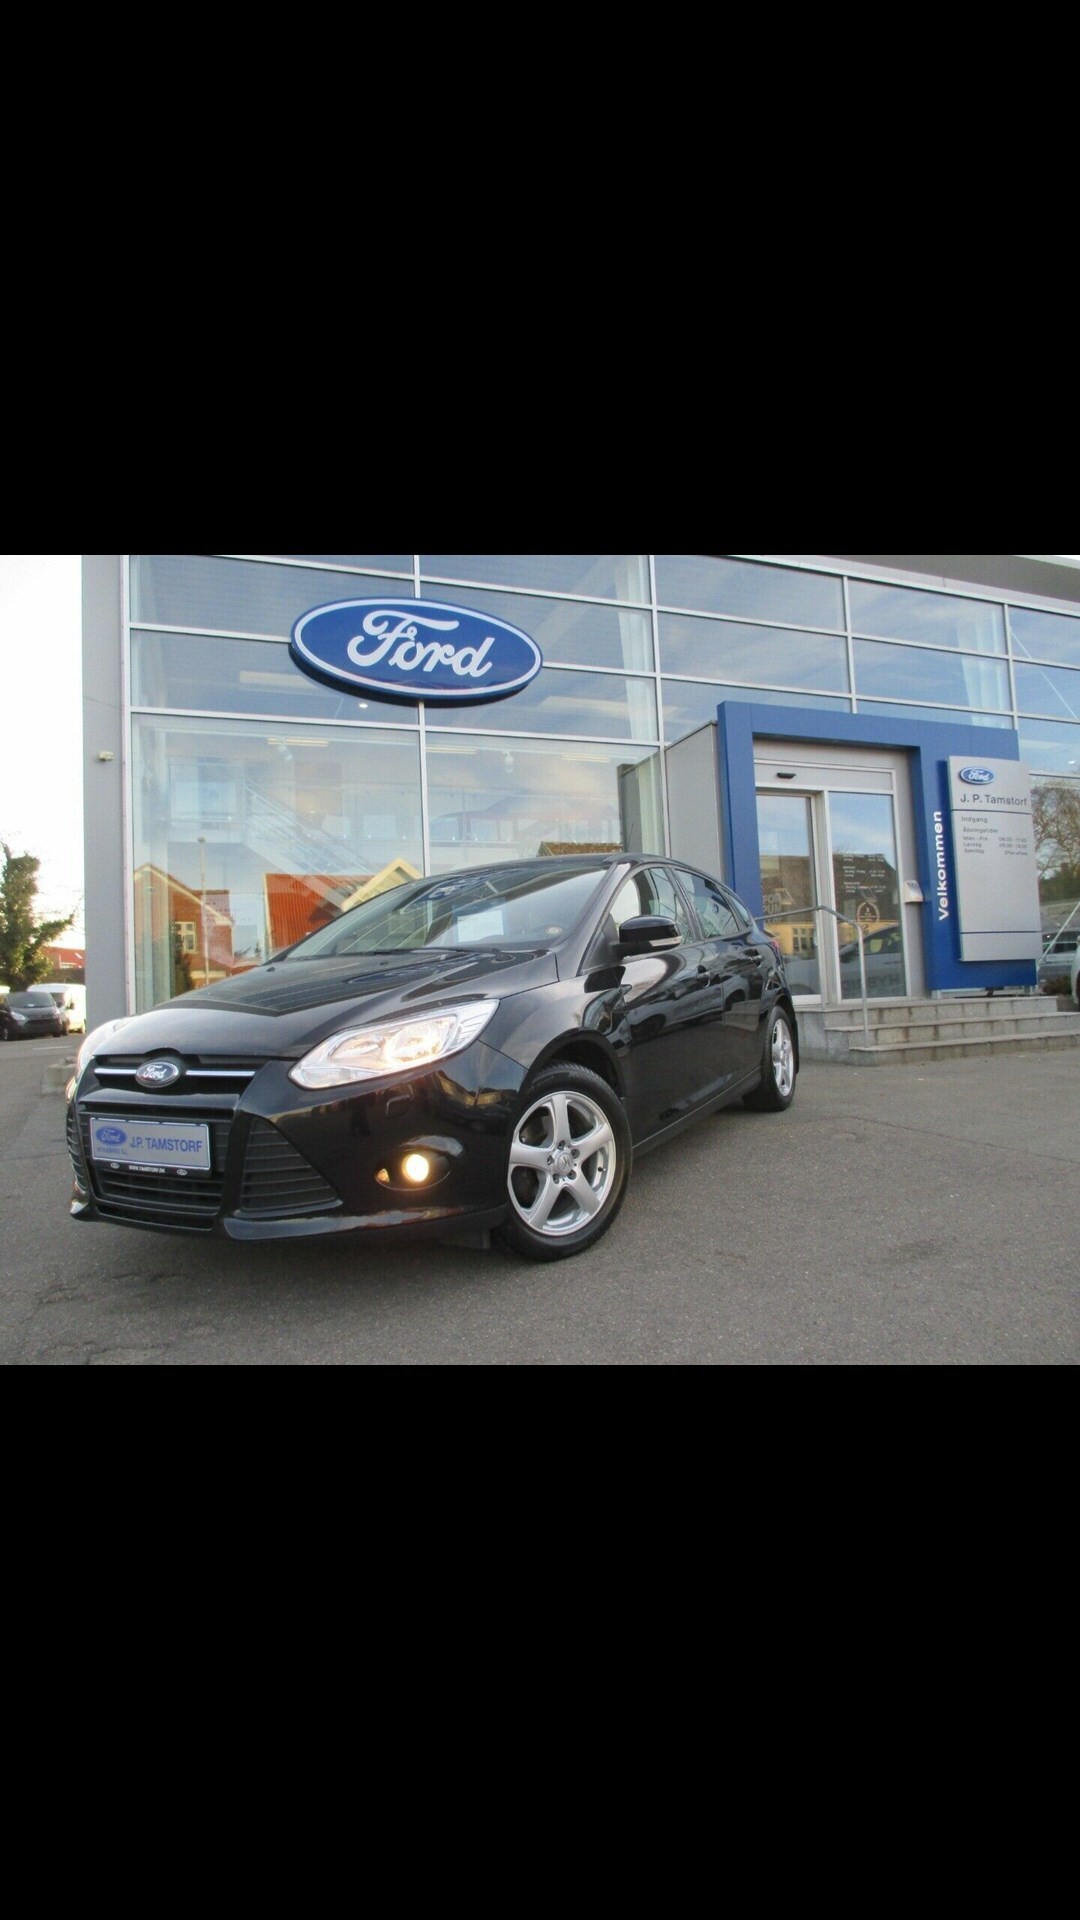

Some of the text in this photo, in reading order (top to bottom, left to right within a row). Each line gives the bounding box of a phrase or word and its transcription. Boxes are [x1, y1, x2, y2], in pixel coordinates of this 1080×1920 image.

[347, 609, 495, 678] Ford
[968, 769, 990, 781] Ford
[960, 793, 1027, 806] J. P. Tamstorf
[933, 811, 949, 920] Velkommen
[143, 1064, 168, 1079] Ford
[101, 1128, 122, 1142] Ford
[130, 1136, 144, 1149] J.P.
[145, 1137, 203, 1153] TAMSTORF
